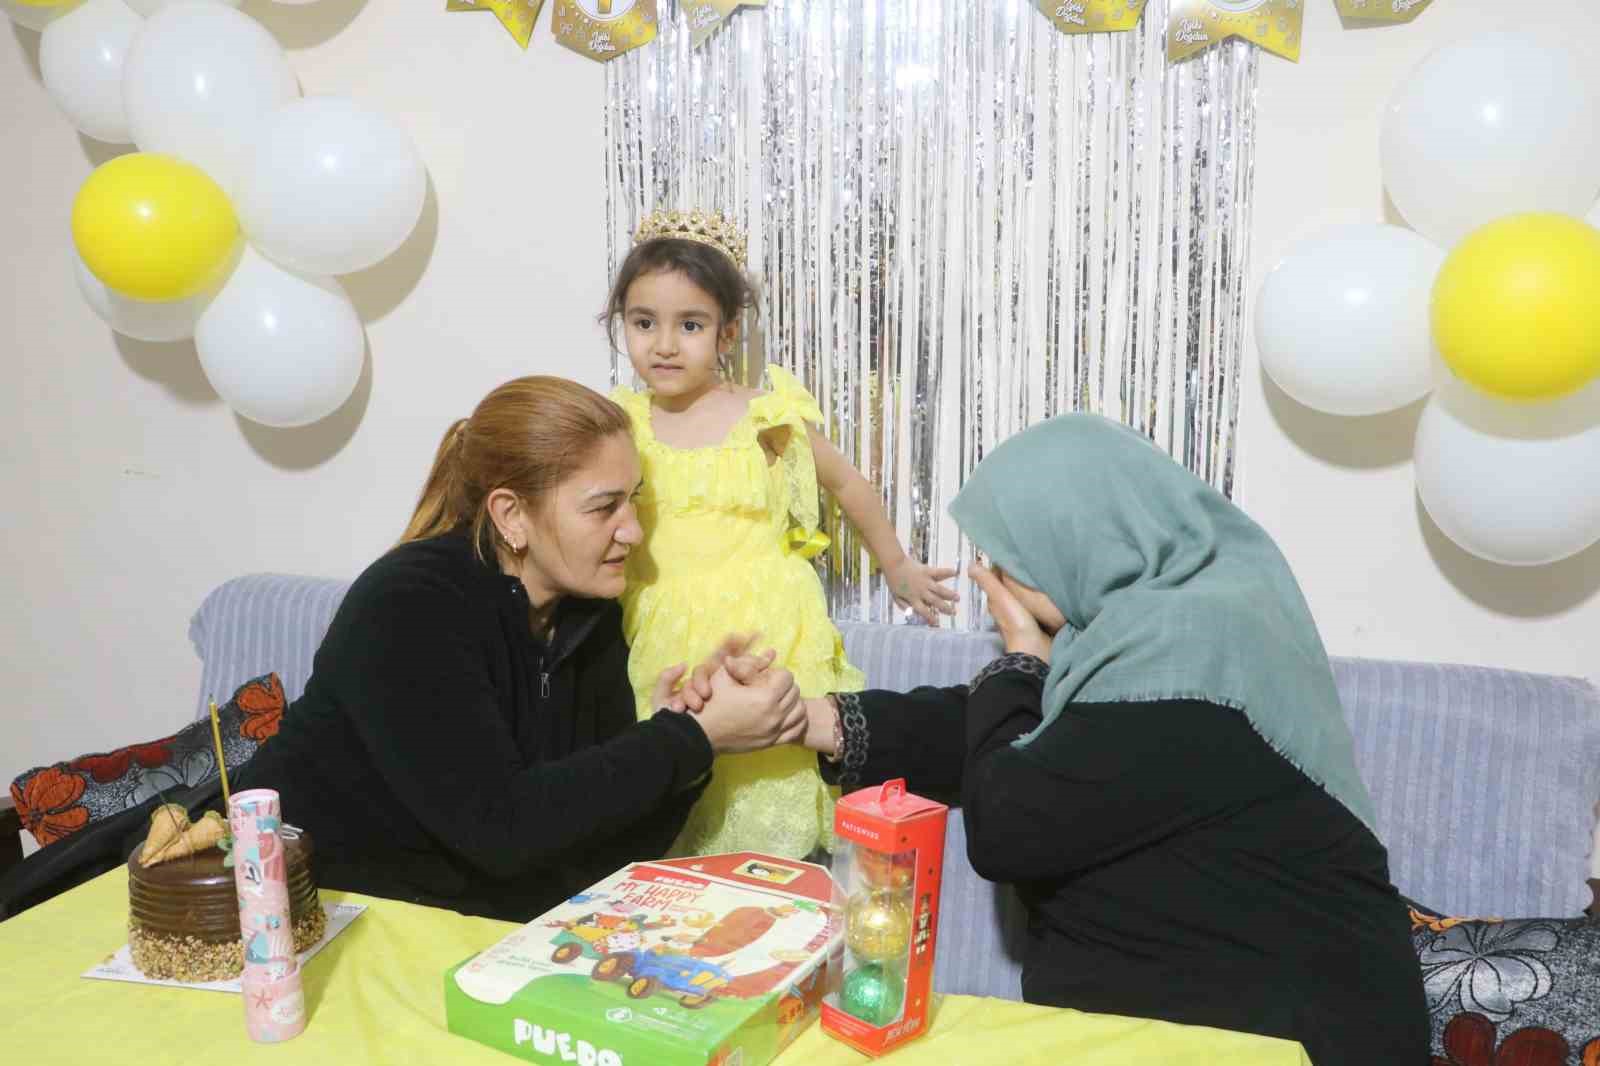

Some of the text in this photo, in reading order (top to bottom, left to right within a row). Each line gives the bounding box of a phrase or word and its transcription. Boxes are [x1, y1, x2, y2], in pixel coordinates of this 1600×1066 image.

[623, 892, 674, 912] FARM
[643, 884, 701, 904] HAPPY
[513, 1018, 623, 1066] PUEDO
